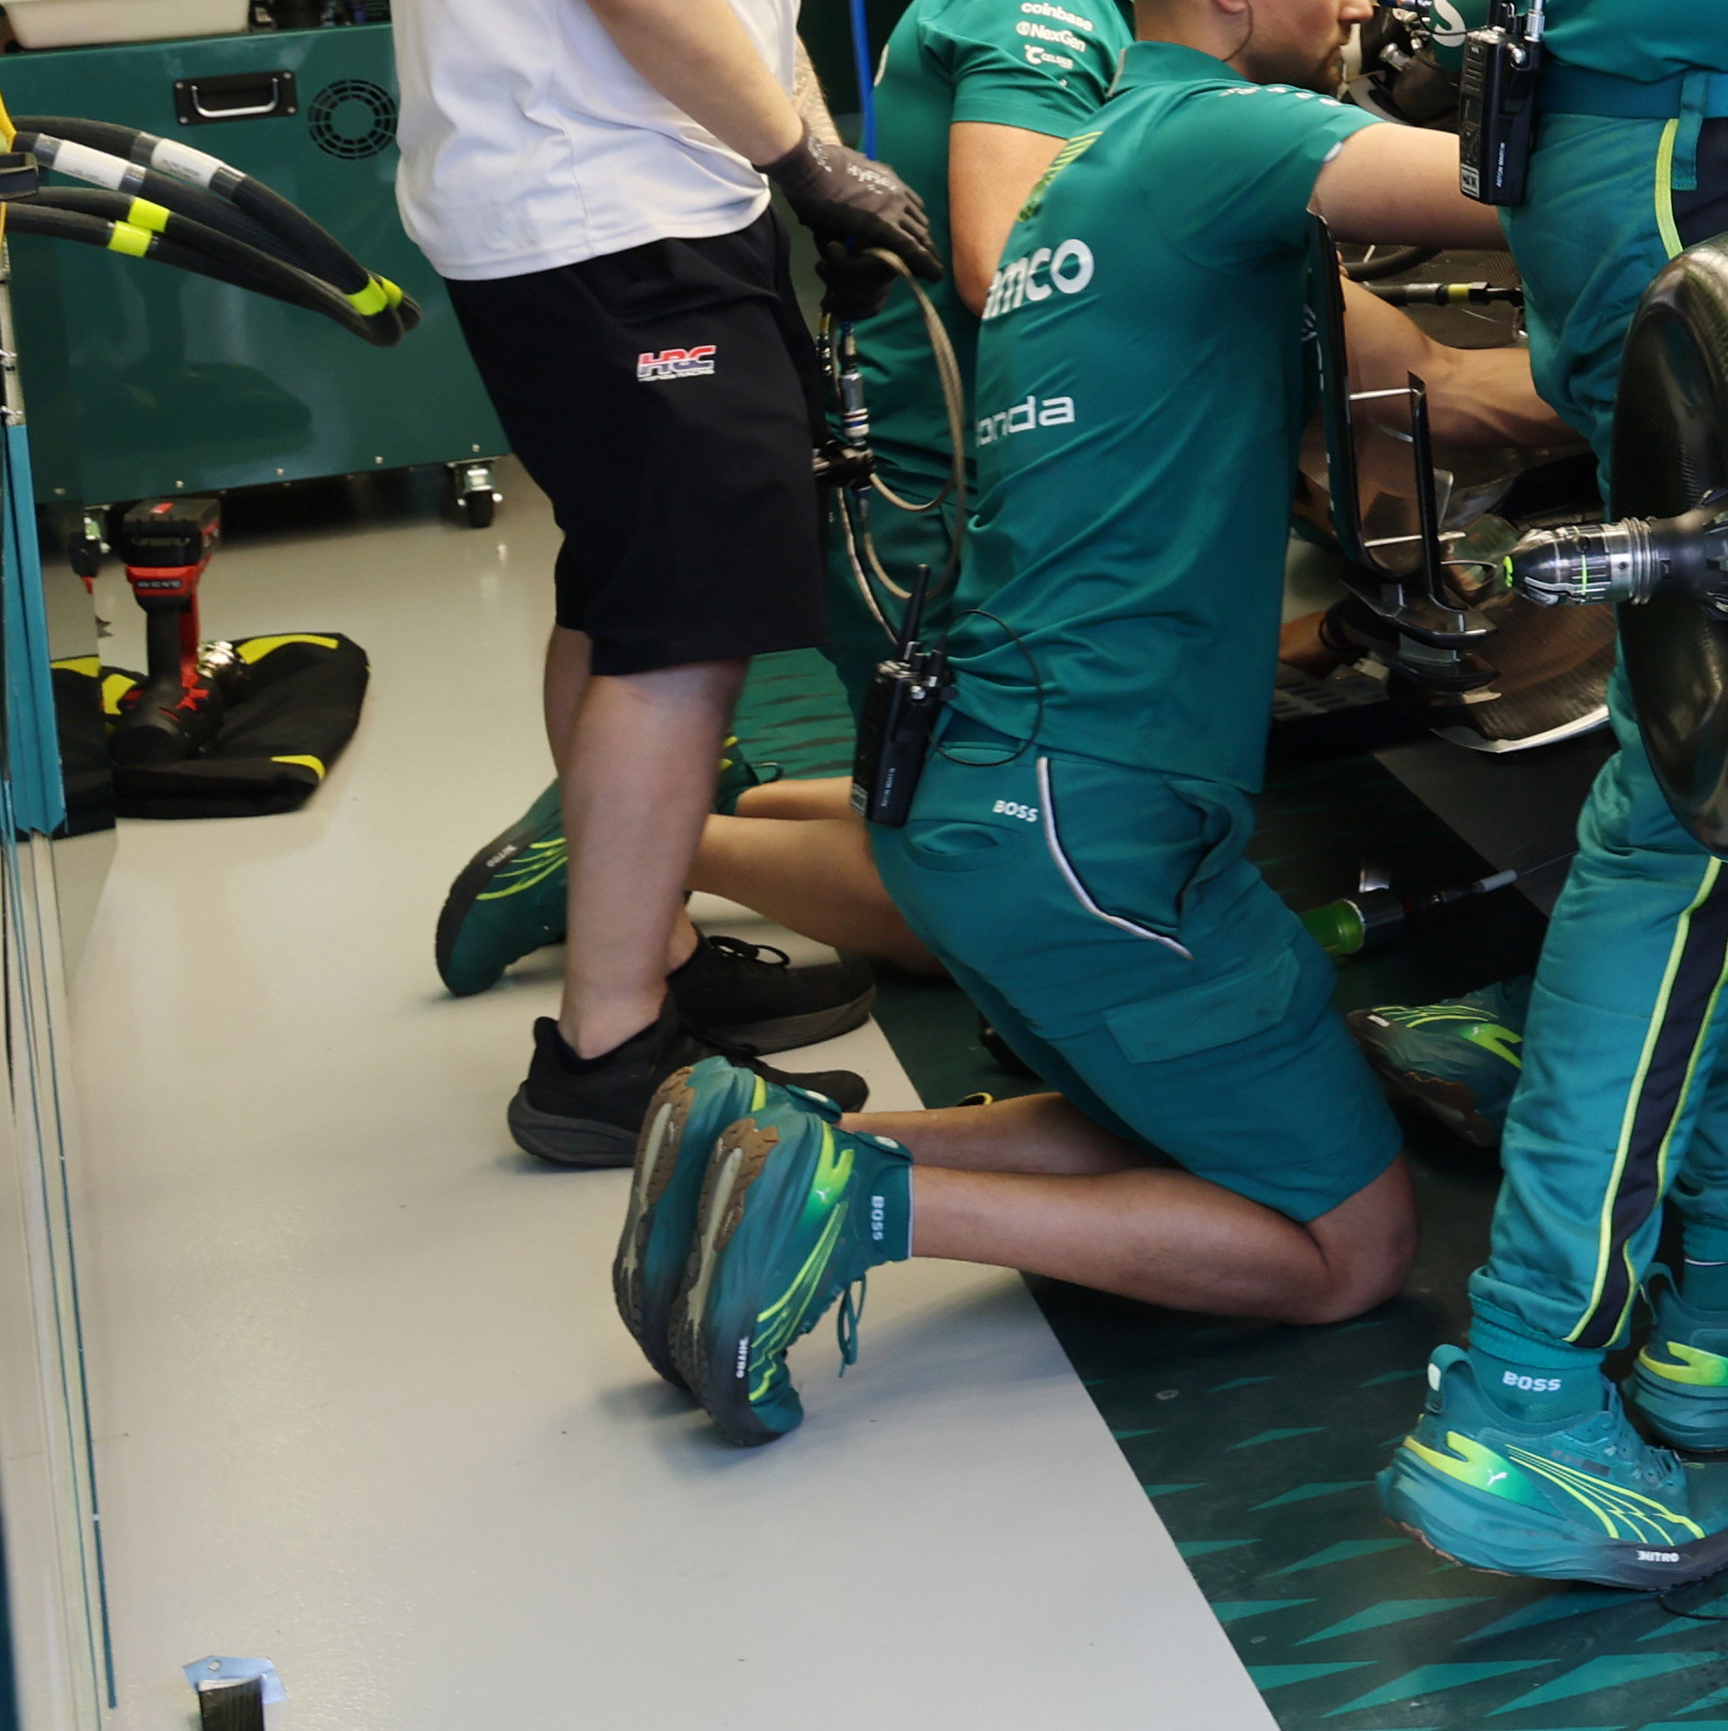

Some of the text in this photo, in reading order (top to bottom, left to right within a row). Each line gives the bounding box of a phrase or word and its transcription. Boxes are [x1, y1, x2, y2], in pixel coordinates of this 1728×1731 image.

[1020, 1, 1094, 32] coinbase
[1029, 23, 1087, 54] NexGen
[637, 344, 717, 377] HRC
[975, 394, 1076, 448] onda
[992, 799, 1039, 823] BOSS
[870, 1195, 886, 1241] BOSS
[735, 1335, 750, 1379] NITRO
[1502, 1370, 1562, 1393] BOSS
